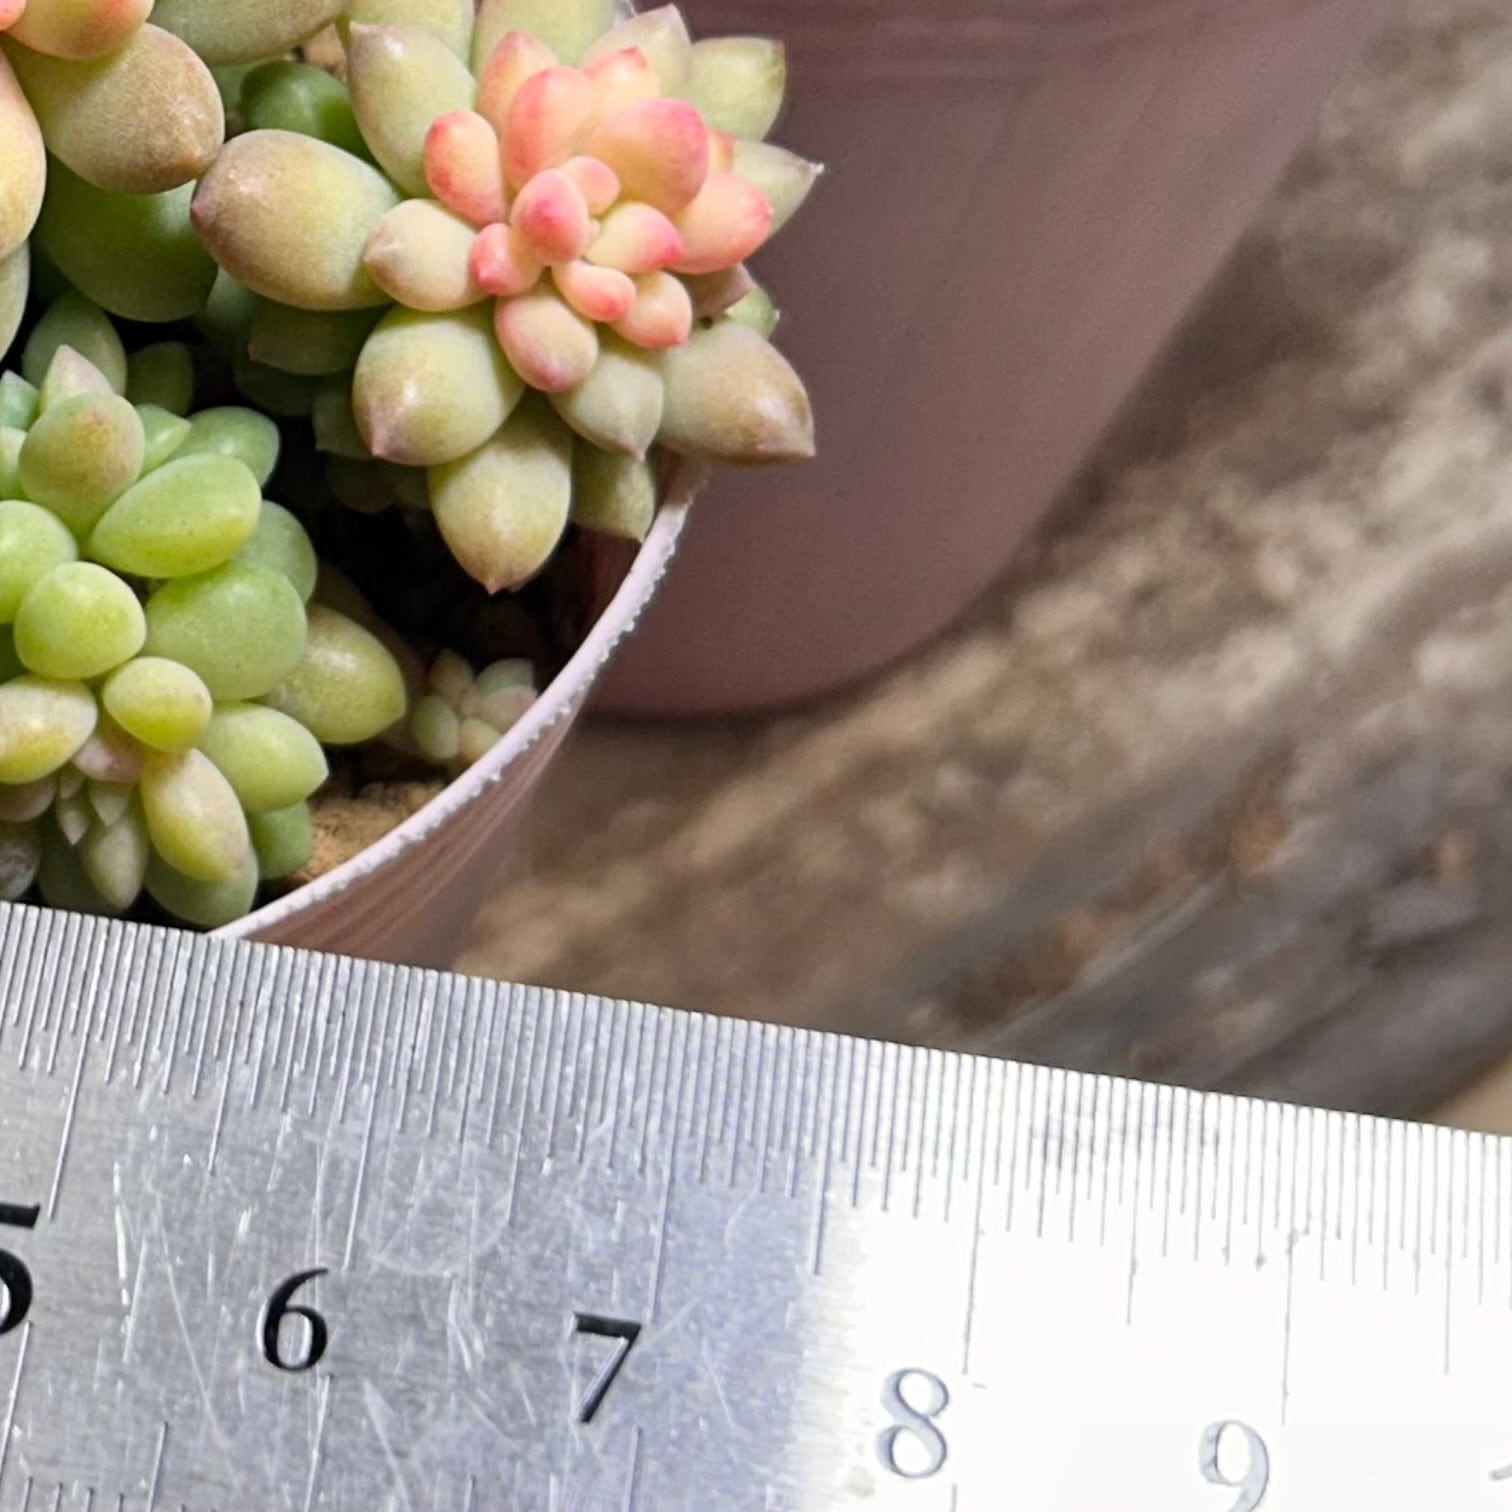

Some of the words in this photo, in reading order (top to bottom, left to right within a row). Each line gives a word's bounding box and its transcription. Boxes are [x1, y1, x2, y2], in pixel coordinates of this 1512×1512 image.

[256, 1266, 331, 1372] 6
[570, 1311, 642, 1424] 7
[875, 1368, 951, 1480] 8
[1197, 1419, 1270, 1512] 9
